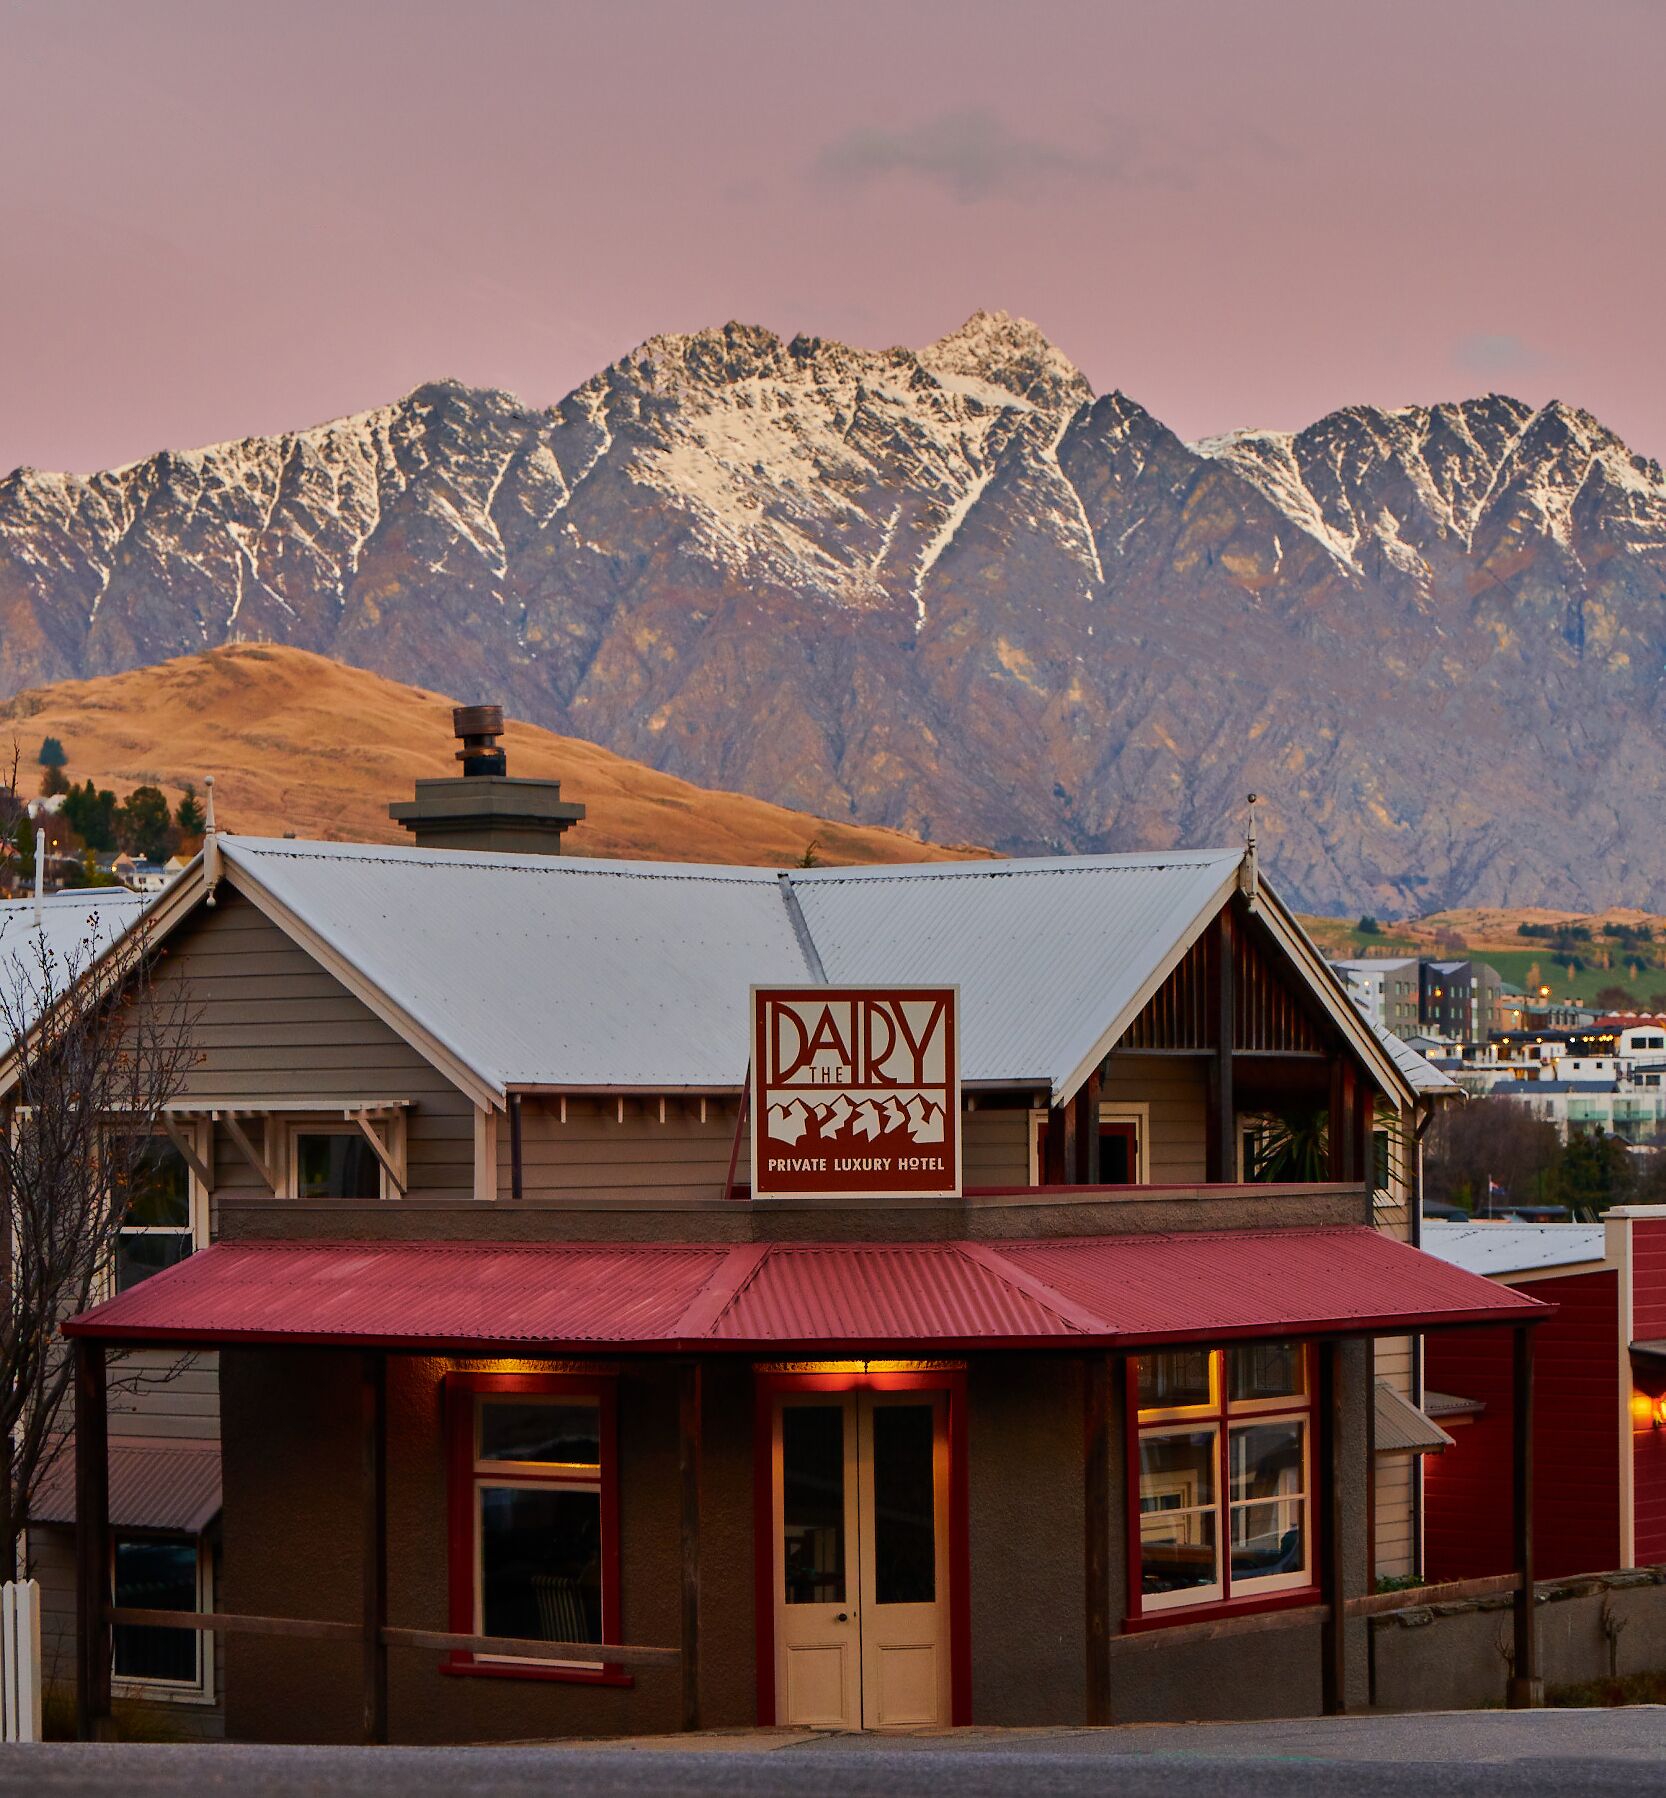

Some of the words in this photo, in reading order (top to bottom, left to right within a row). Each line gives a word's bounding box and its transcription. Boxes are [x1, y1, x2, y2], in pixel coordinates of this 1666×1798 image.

[771, 1001, 944, 1083] DAIRY
[809, 1066, 843, 1083] THE
[768, 1158, 827, 1172] PRIVATE
[834, 1158, 892, 1171] LUXURY
[898, 1157, 945, 1171] HOTEL
